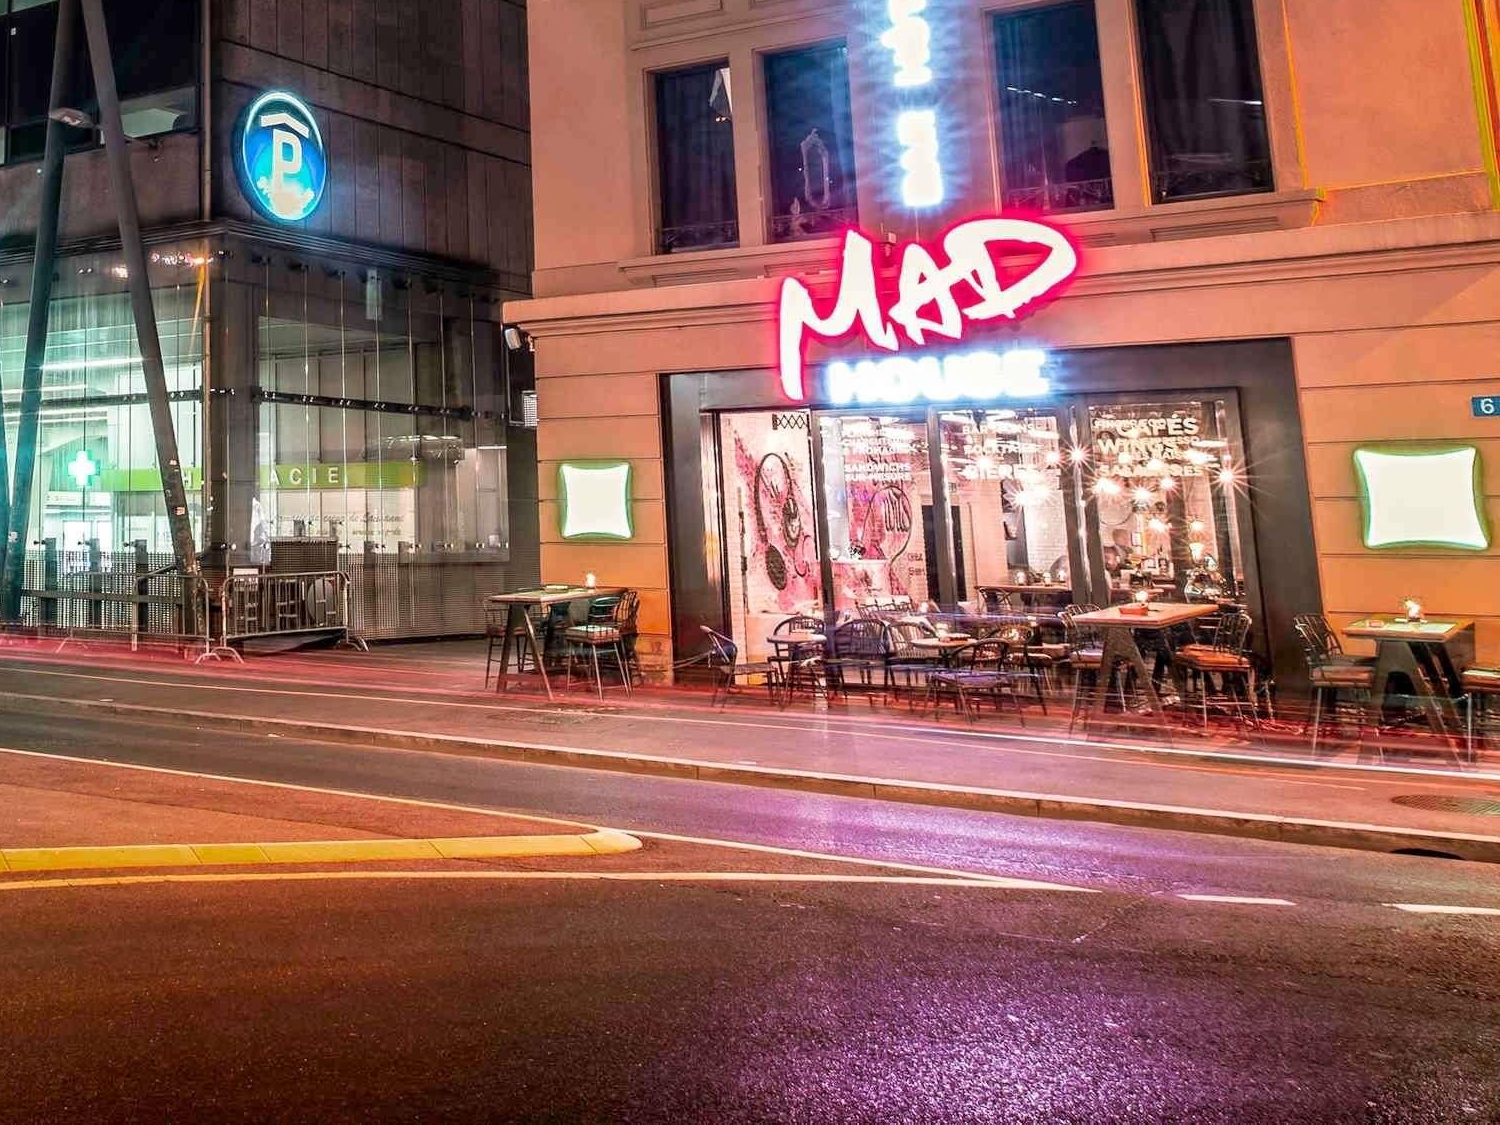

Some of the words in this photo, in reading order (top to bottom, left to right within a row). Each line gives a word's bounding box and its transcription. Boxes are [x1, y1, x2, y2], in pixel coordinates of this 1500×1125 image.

[272, 128, 303, 192] P
[780, 218, 1077, 401] MAD
[828, 350, 1050, 404] HOUSE
[1480, 398, 1495, 415] 6
